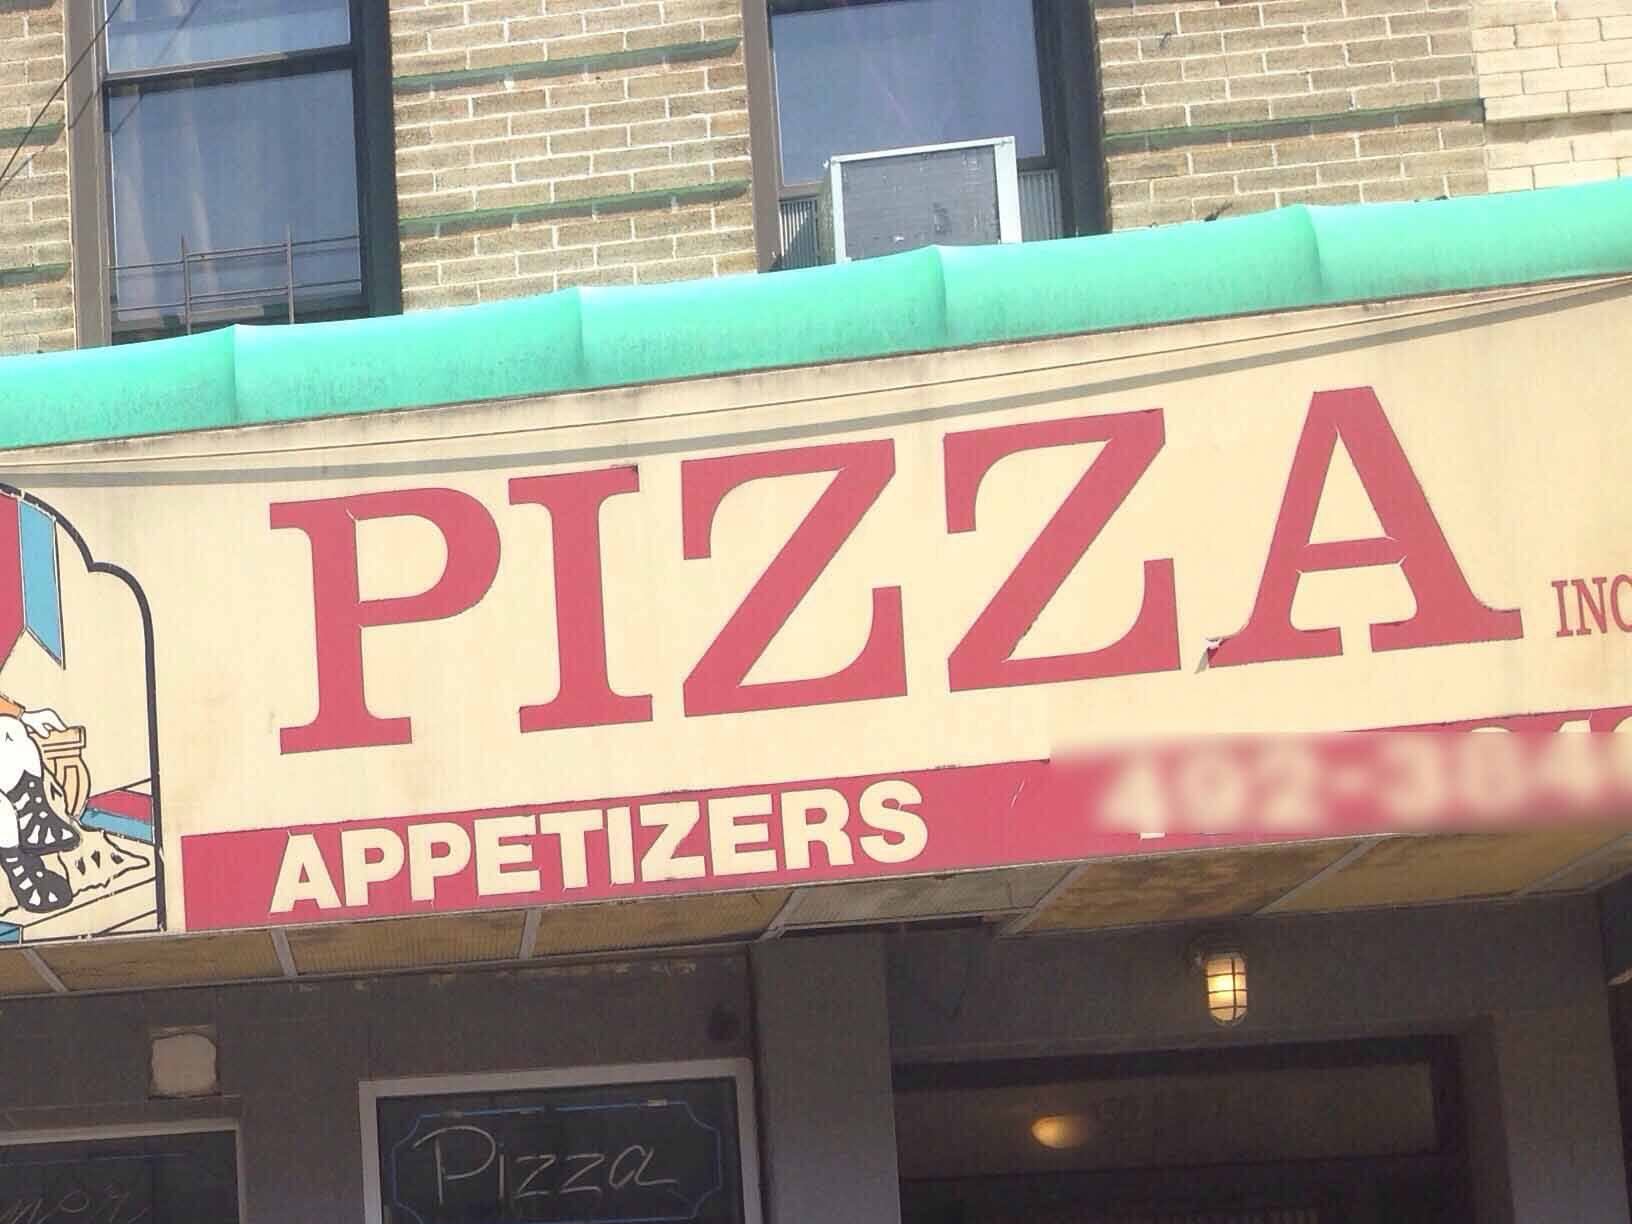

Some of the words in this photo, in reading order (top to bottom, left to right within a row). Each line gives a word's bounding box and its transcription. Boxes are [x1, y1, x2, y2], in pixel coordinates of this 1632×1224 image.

[269, 385, 1524, 755] PIZZA
[1551, 573, 1632, 637] INC
[269, 779, 929, 914] APPETIZERS
[413, 1125, 679, 1205] Pizza
